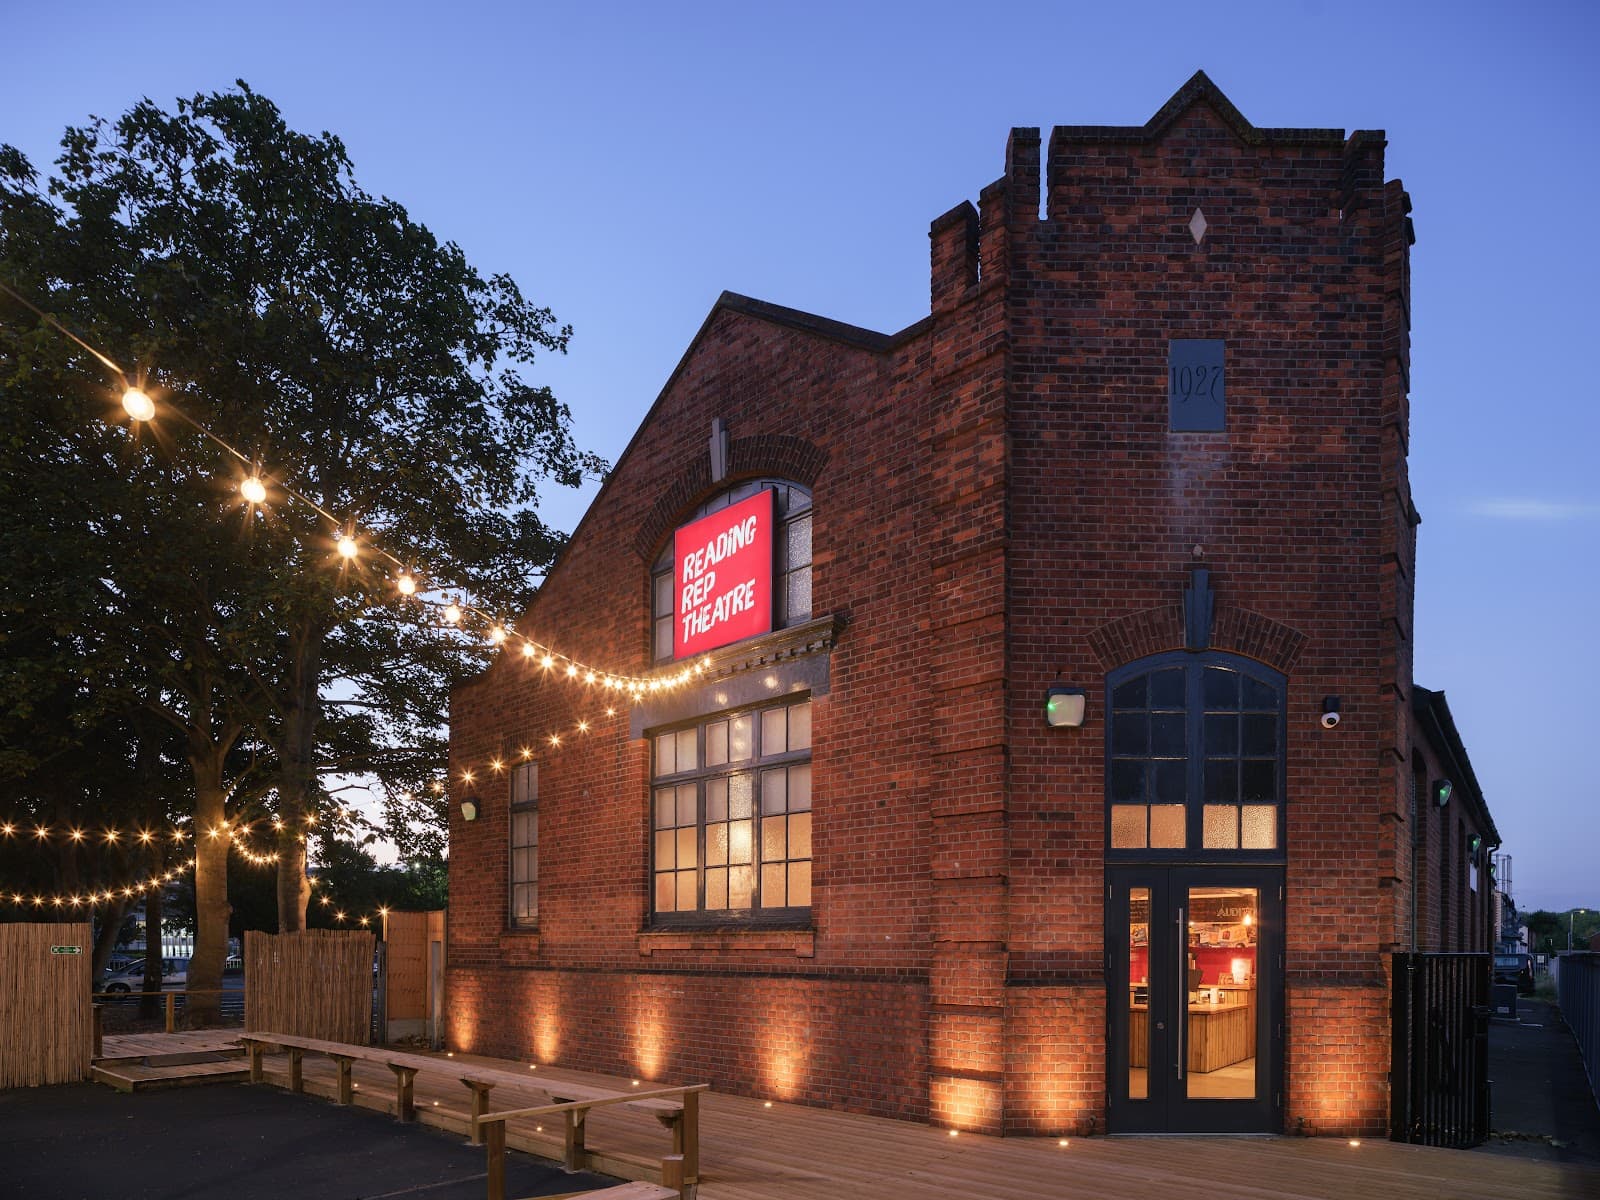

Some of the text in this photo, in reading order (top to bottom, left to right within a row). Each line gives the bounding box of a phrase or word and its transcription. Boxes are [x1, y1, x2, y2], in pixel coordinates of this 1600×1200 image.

[1172, 365, 1223, 404] 1927
[681, 571, 716, 614] REP
[682, 578, 756, 644] THEATRE
